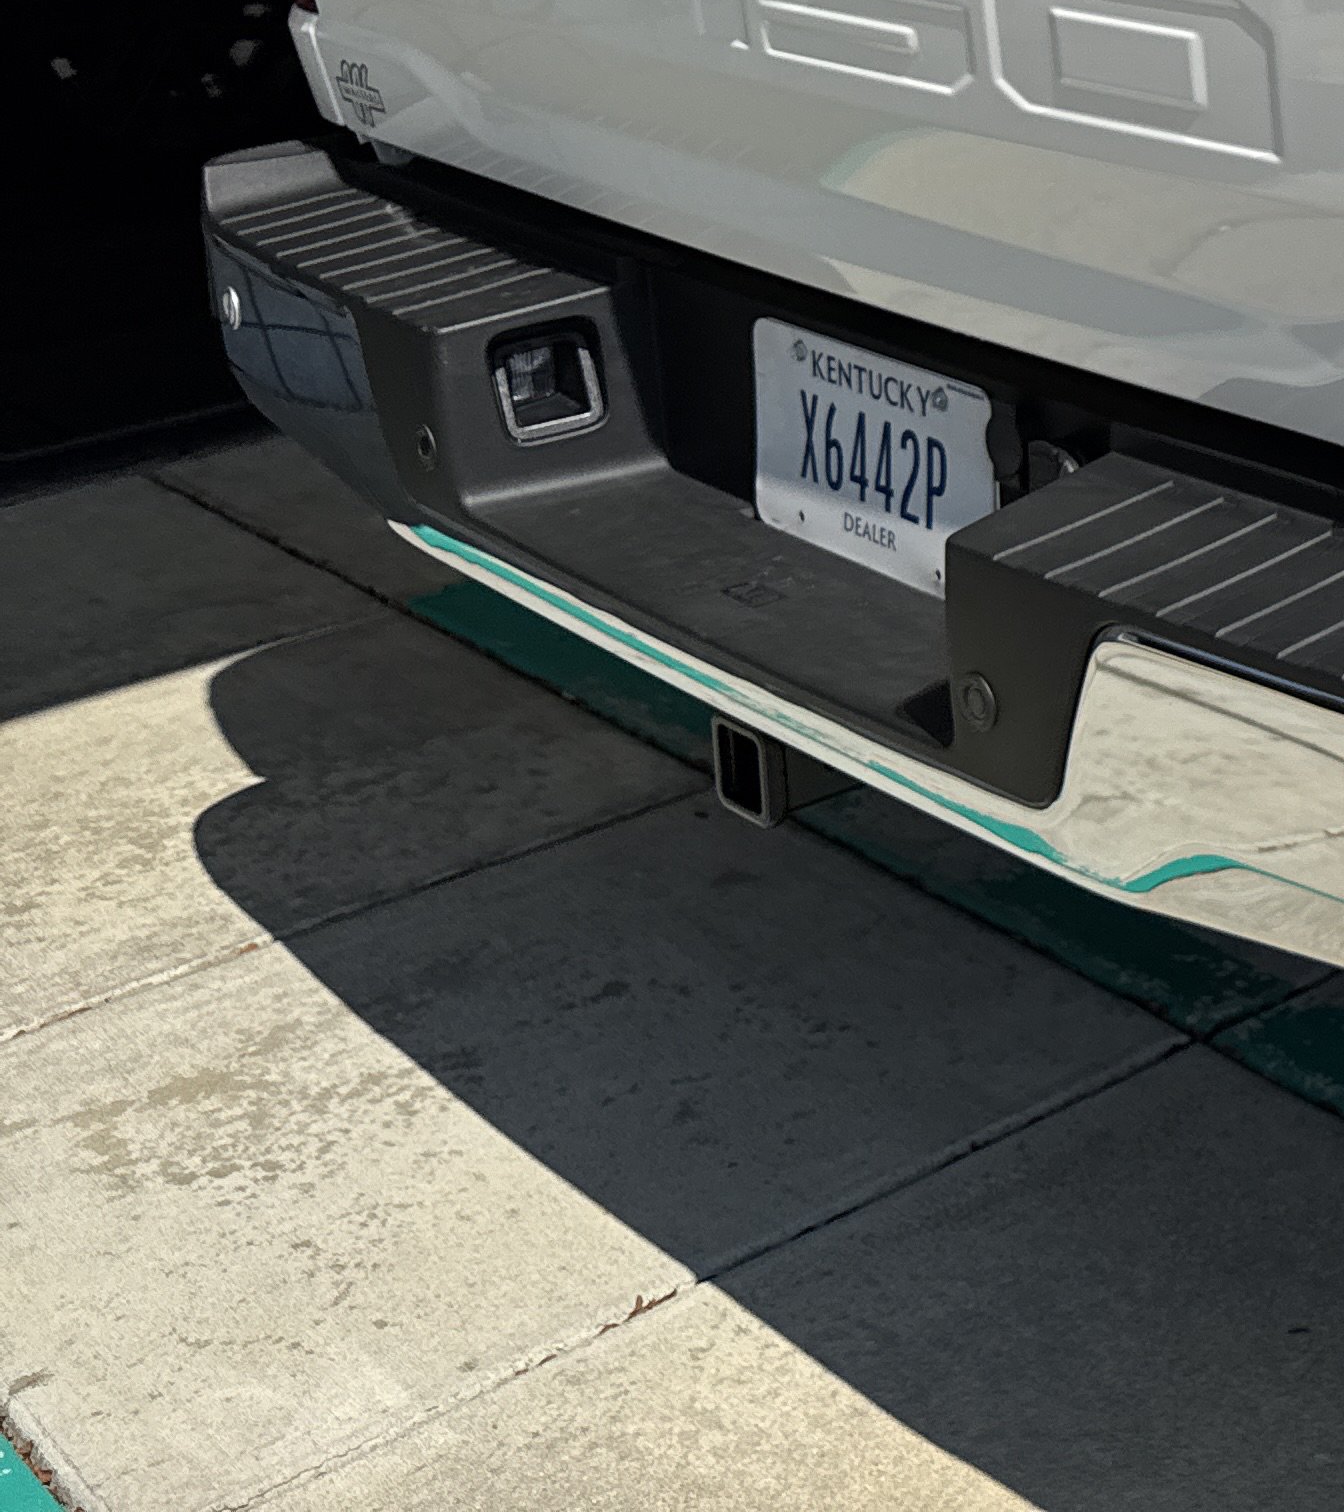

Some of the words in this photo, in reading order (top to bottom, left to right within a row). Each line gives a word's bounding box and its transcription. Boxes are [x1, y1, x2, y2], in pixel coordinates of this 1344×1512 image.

[811, 349, 930, 417] KENTUCKY
[800, 389, 948, 530] X6442P
[843, 511, 897, 552] DEALER
